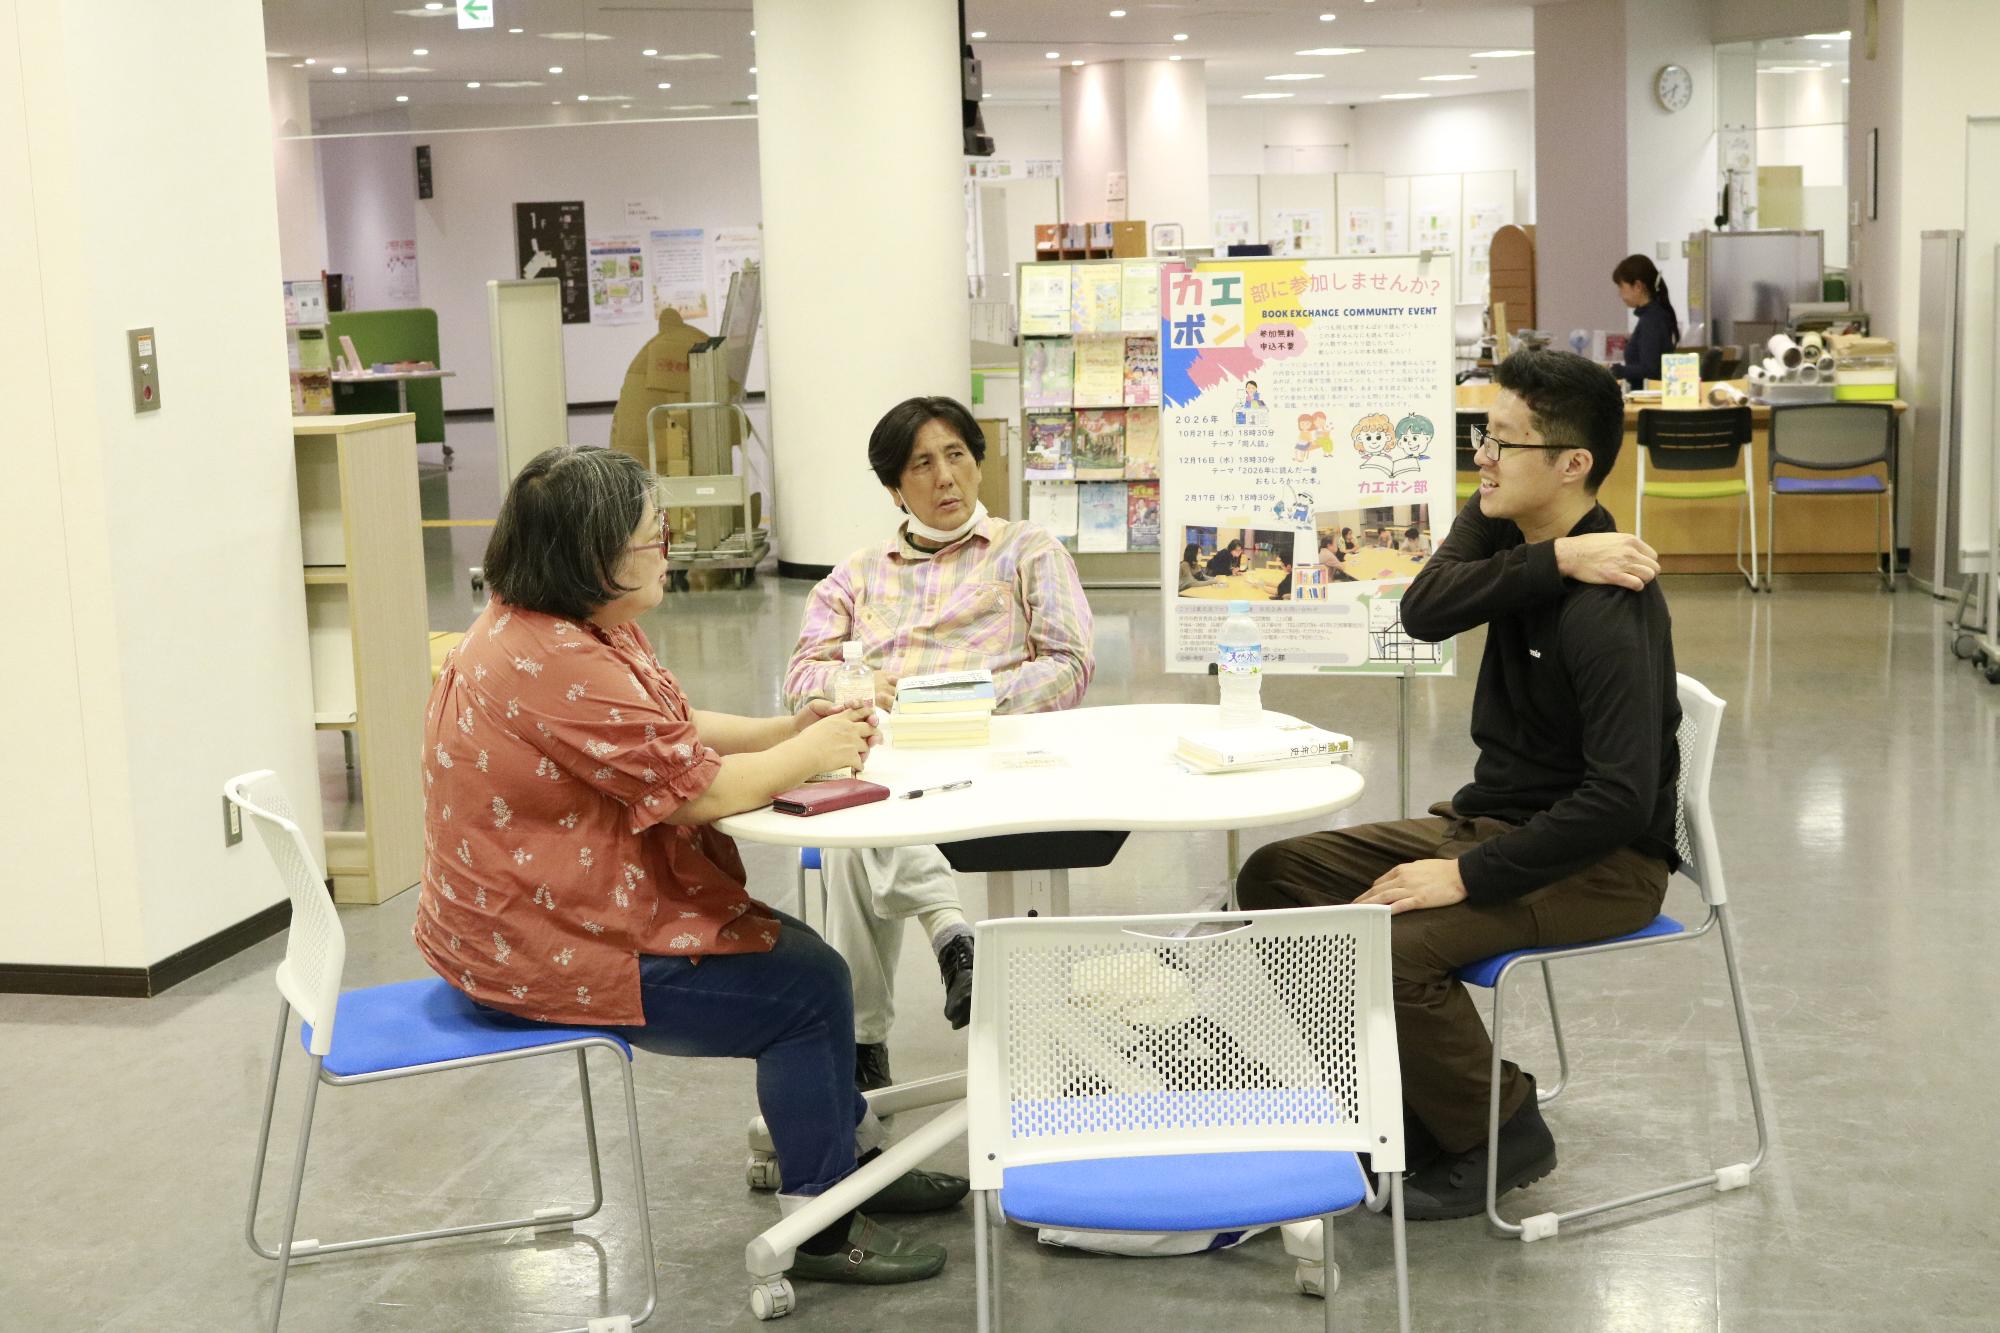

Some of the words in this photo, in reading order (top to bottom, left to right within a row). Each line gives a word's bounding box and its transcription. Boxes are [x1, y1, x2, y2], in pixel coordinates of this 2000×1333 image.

[1172, 275, 1242, 306] カエ
[1250, 272, 1441, 304] 部に参加しませんか?
[1262, 310, 1288, 318] BOOK
[1290, 309, 1339, 317] EXCHANGE
[1343, 308, 1404, 317] COMMUNITY
[1408, 307, 1437, 316] EVENT
[1260, 329, 1295, 338] 参加無料
[1260, 342, 1295, 351] 申込不要
[1175, 416, 1219, 424] 2026年
[1358, 480, 1428, 494] カエボン部
